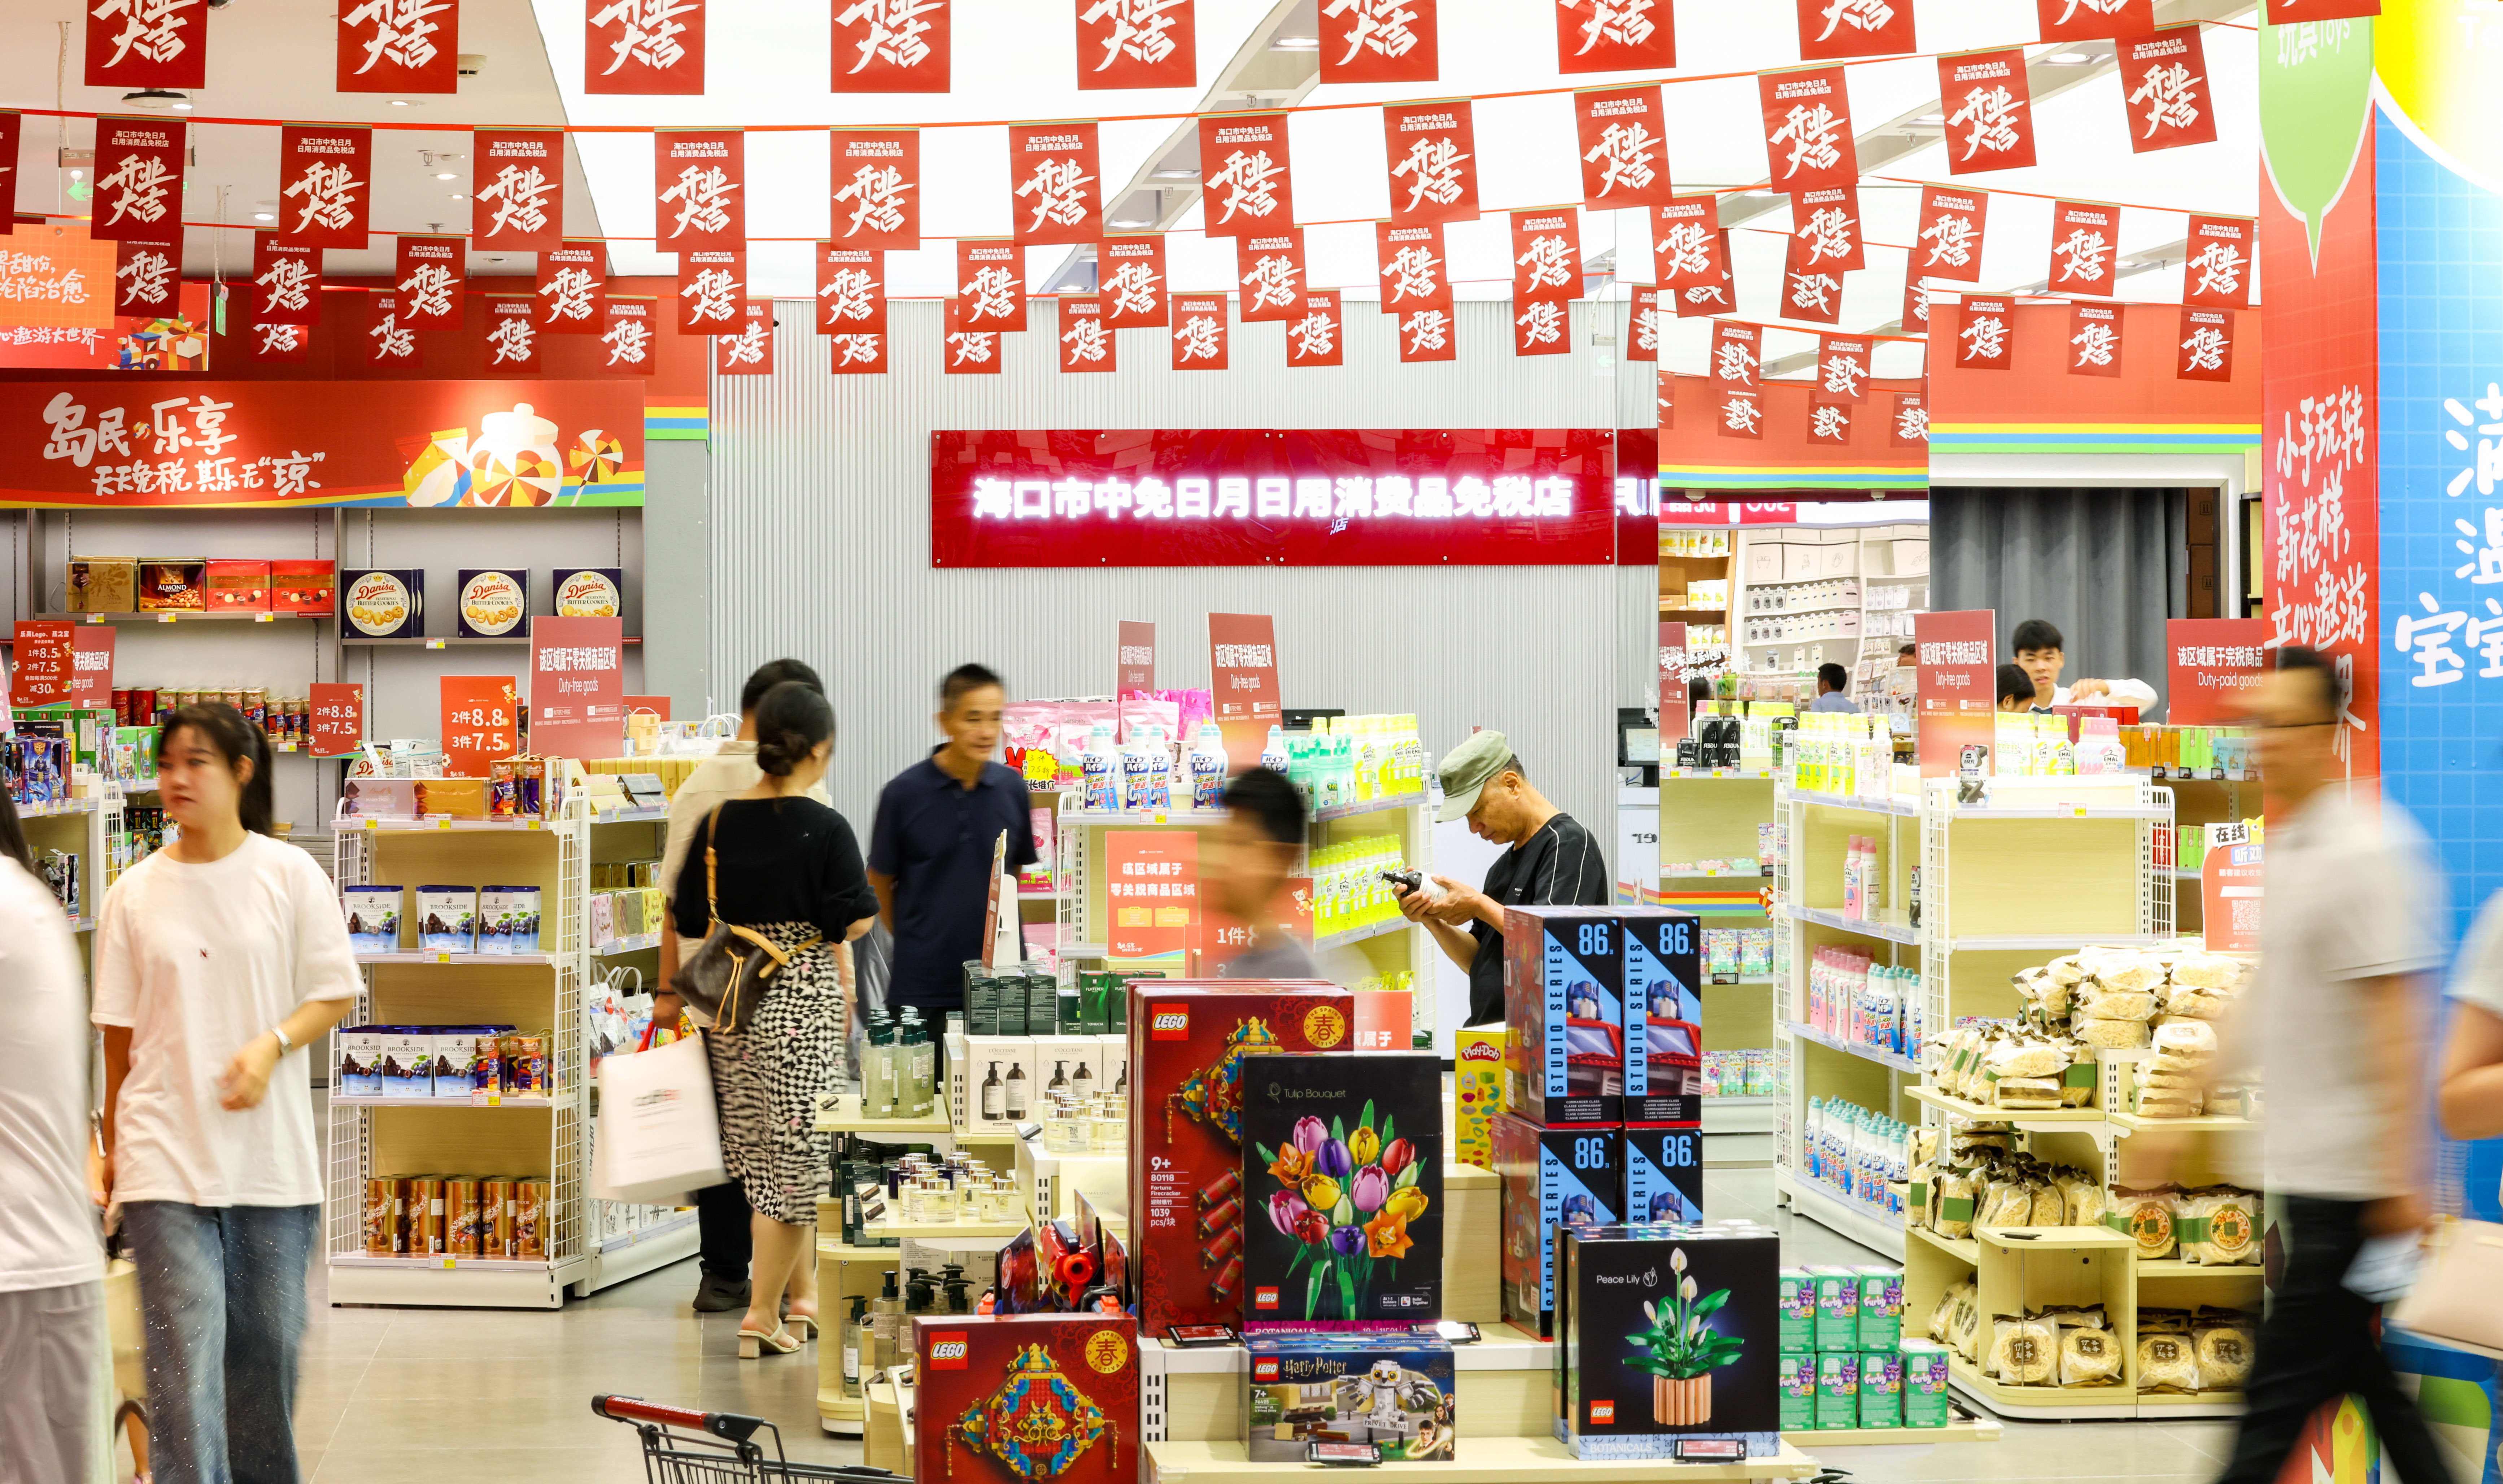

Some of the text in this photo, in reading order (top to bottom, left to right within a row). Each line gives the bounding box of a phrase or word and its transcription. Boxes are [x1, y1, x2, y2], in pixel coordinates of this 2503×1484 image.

[1775, 86, 1832, 99] 日用消费品免税店
[1777, 78, 1827, 92] 海口市中免日月
[111, 138, 169, 148] 日用消费品免税店
[115, 131, 166, 139] 海口市中免日月
[1028, 134, 1079, 144] 海口市中免日月
[670, 149, 729, 158] 日用消费品免税店
[673, 141, 724, 150] 海口市中免日月
[1025, 141, 1083, 152] 日用消费品免税店
[968, 253, 1013, 262] 日用消费品免税店
[2276, 385, 2364, 487] 小手玩转
[972, 476, 1574, 520] 海口市中免日月日用消费品免税店
[356, 582, 397, 600] Danisa
[470, 582, 511, 599] Danisa
[565, 581, 606, 599] Danisa
[539, 646, 616, 672] 该区域属于零关税商品区域
[1215, 643, 1273, 668] 该区域属于零关税商品区域
[1920, 641, 1988, 666] 该区域属于零关税商品区域
[81, 676, 93, 691] goods
[559, 677, 598, 696] Duty-free goods
[1231, 674, 1260, 693] Duty-free goods
[1936, 671, 1970, 689] Duty-free goods
[2198, 672, 2237, 690] Duty-paid
[2216, 824, 2245, 843] 在线
[1122, 862, 1182, 876] 该区域属于
[1110, 883, 1195, 896] 零关税商品区域
[1579, 924, 1609, 955] 86
[1660, 923, 1688, 955] 86
[1154, 1014, 1187, 1030] LEGO
[1550, 944, 1563, 1093] STUDIO SERIES
[1630, 943, 1643, 1092] STUDIO SERIES
[1313, 1014, 1335, 1040] 春
[1462, 1046, 1500, 1062] Play-Doh
[1284, 1089, 1346, 1100] Tulip Bouquet
[1575, 1137, 1604, 1169] 86
[1662, 1135, 1691, 1167] 86
[1151, 1156, 1171, 1170] 9+
[1545, 1158, 1558, 1225] SERIES
[1633, 1157, 1646, 1221] SERIES
[1151, 1208, 1170, 1217] 1039
[1597, 1275, 1640, 1285] Peace Lily
[1256, 1293, 1277, 1302] LEGO
[1820, 1297, 1843, 1308] Furby
[1863, 1296, 1887, 1308] Furby
[931, 1343, 967, 1359] LEGO
[1095, 1339, 1118, 1366] 春
[1256, 1357, 1347, 1379] LEGO Harry Potter
[1820, 1374, 1843, 1386] Furby
[1864, 1373, 1887, 1385] Furby
[1909, 1373, 1932, 1385] Furby
[1255, 1389, 1266, 1398] 7+
[1590, 1441, 1652, 1452] BOTANICALS
[1756, 1442, 1769, 1452] pcs
